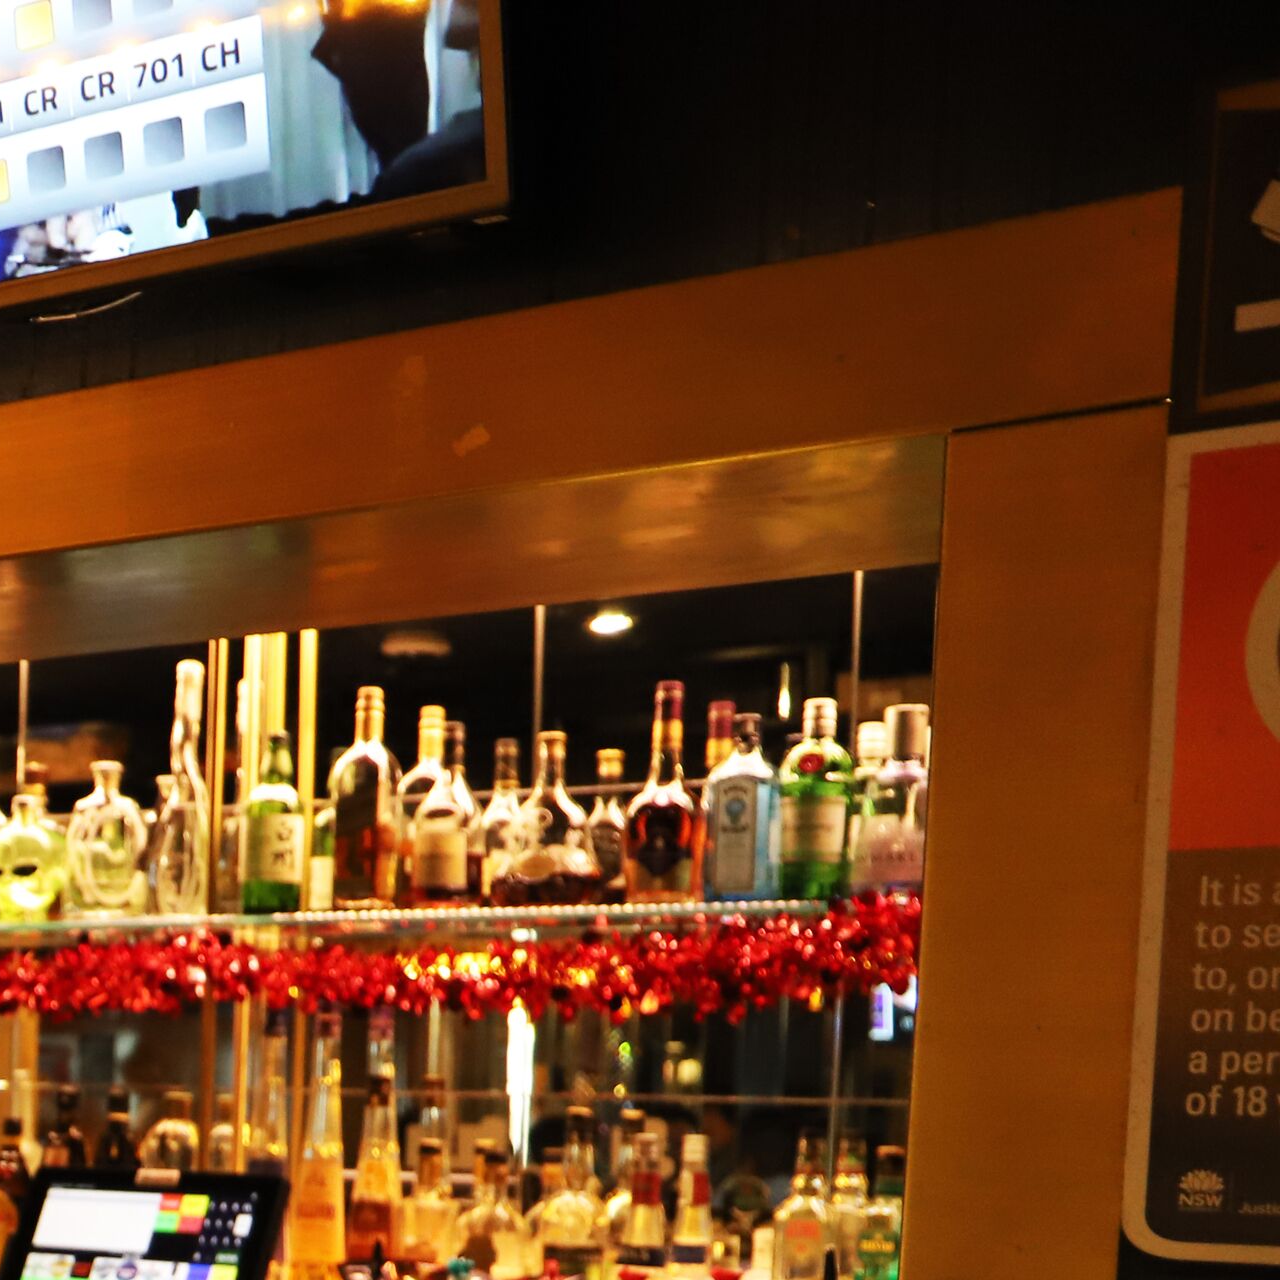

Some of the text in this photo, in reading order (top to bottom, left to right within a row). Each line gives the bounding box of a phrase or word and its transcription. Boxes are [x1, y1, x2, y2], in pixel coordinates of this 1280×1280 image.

[22, 86, 58, 118] CR
[79, 69, 115, 102] CR
[134, 52, 185, 89] 701
[201, 37, 241, 72] CH
[1200, 875, 1260, 906] It is
[1195, 921, 1232, 949] to
[1192, 965, 1236, 994] to,
[1191, 1008, 1234, 1033] on
[1188, 1050, 1208, 1074] a
[1185, 1085, 1268, 1117] of 18
[1178, 1192, 1224, 1208] NSW
